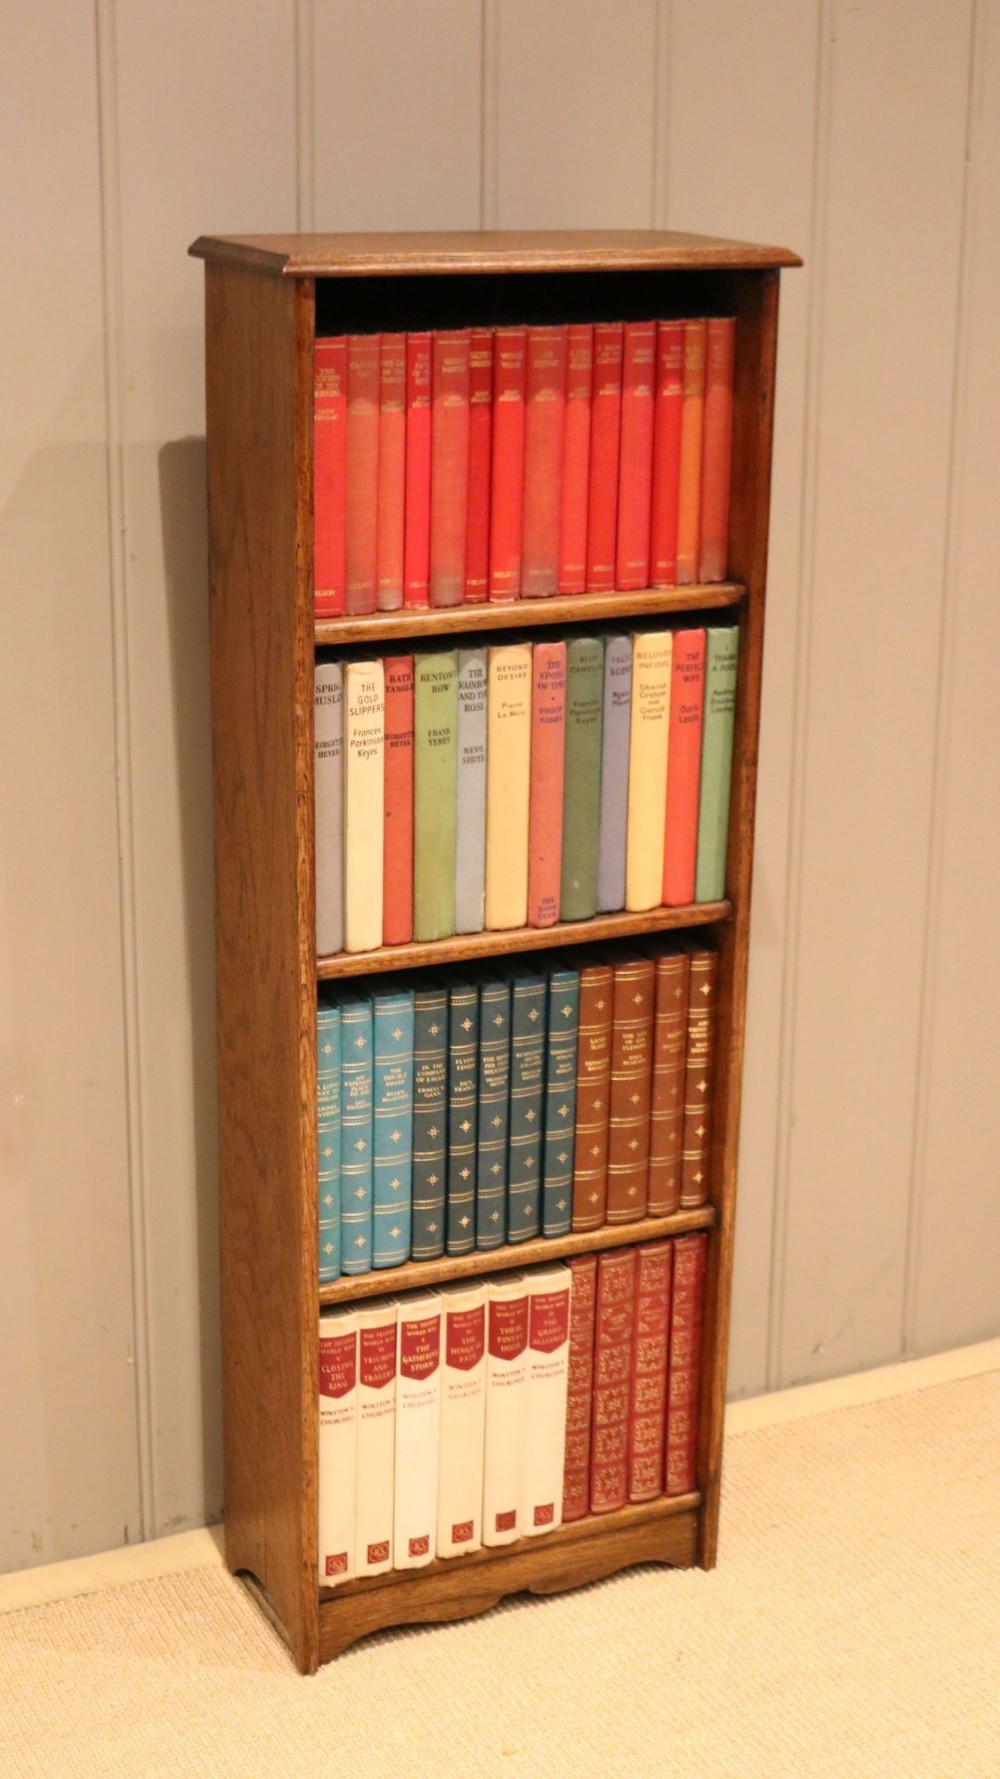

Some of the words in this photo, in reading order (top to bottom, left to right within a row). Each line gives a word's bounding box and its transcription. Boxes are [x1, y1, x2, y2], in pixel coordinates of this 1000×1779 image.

[496, 664, 529, 672] BEYOND
[389, 673, 412, 683] BATH
[468, 669, 483, 678] THE
[497, 672, 527, 681] DESIRE
[361, 683, 376, 692] THE
[432, 684, 449, 693] ROW
[357, 695, 379, 705] GOLD
[458, 692, 475, 700] AND
[350, 704, 384, 716] SLIPPERS
[464, 703, 484, 712] ROSE
[353, 728, 381, 737] Frances
[428, 728, 450, 737] FRANK
[357, 748, 378, 760] Keyes
[462, 1337, 475, 1345] THE
[416, 1344, 429, 1353] THE
[459, 1354, 476, 1363] FATE
[321, 1361, 354, 1373] CLOSING
[410, 1361, 434, 1372] STORM
[331, 1373, 345, 1381] THE
[328, 1381, 348, 1390] RING
[362, 1400, 390, 1409] WINSTON
